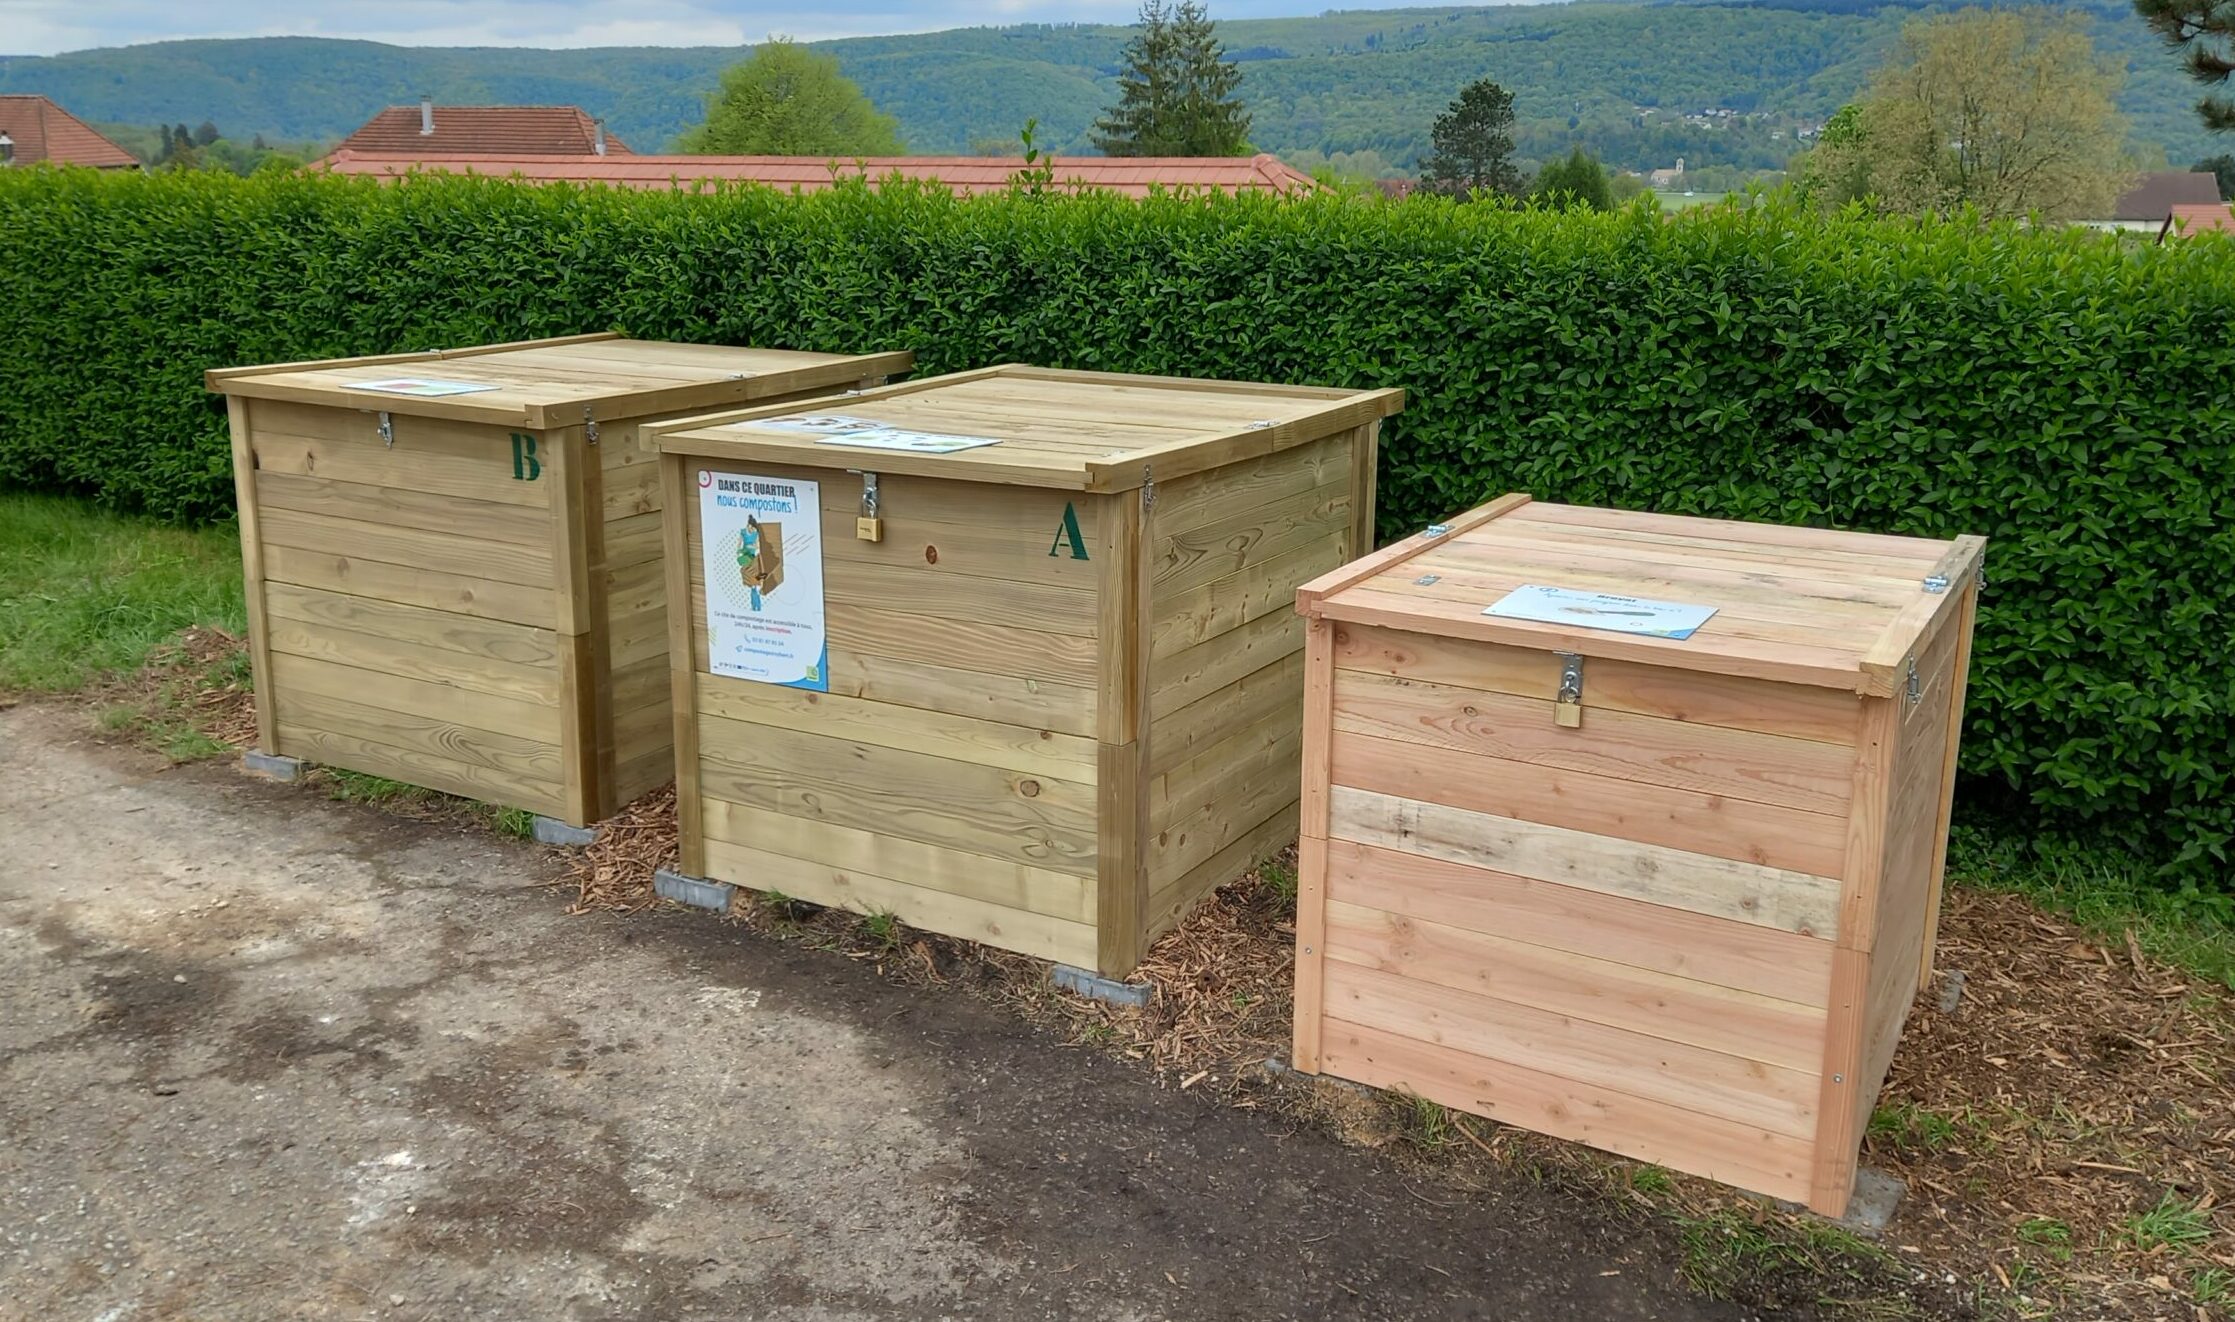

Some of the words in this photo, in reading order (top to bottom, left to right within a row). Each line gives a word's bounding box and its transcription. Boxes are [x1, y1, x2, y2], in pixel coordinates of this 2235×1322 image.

[508, 432, 540, 481] B
[717, 495, 737, 507] nous
[718, 480, 740, 492] DANS
[742, 482, 752, 493] CE
[754, 483, 795, 497] QUARTIER
[1048, 501, 1090, 561] A
